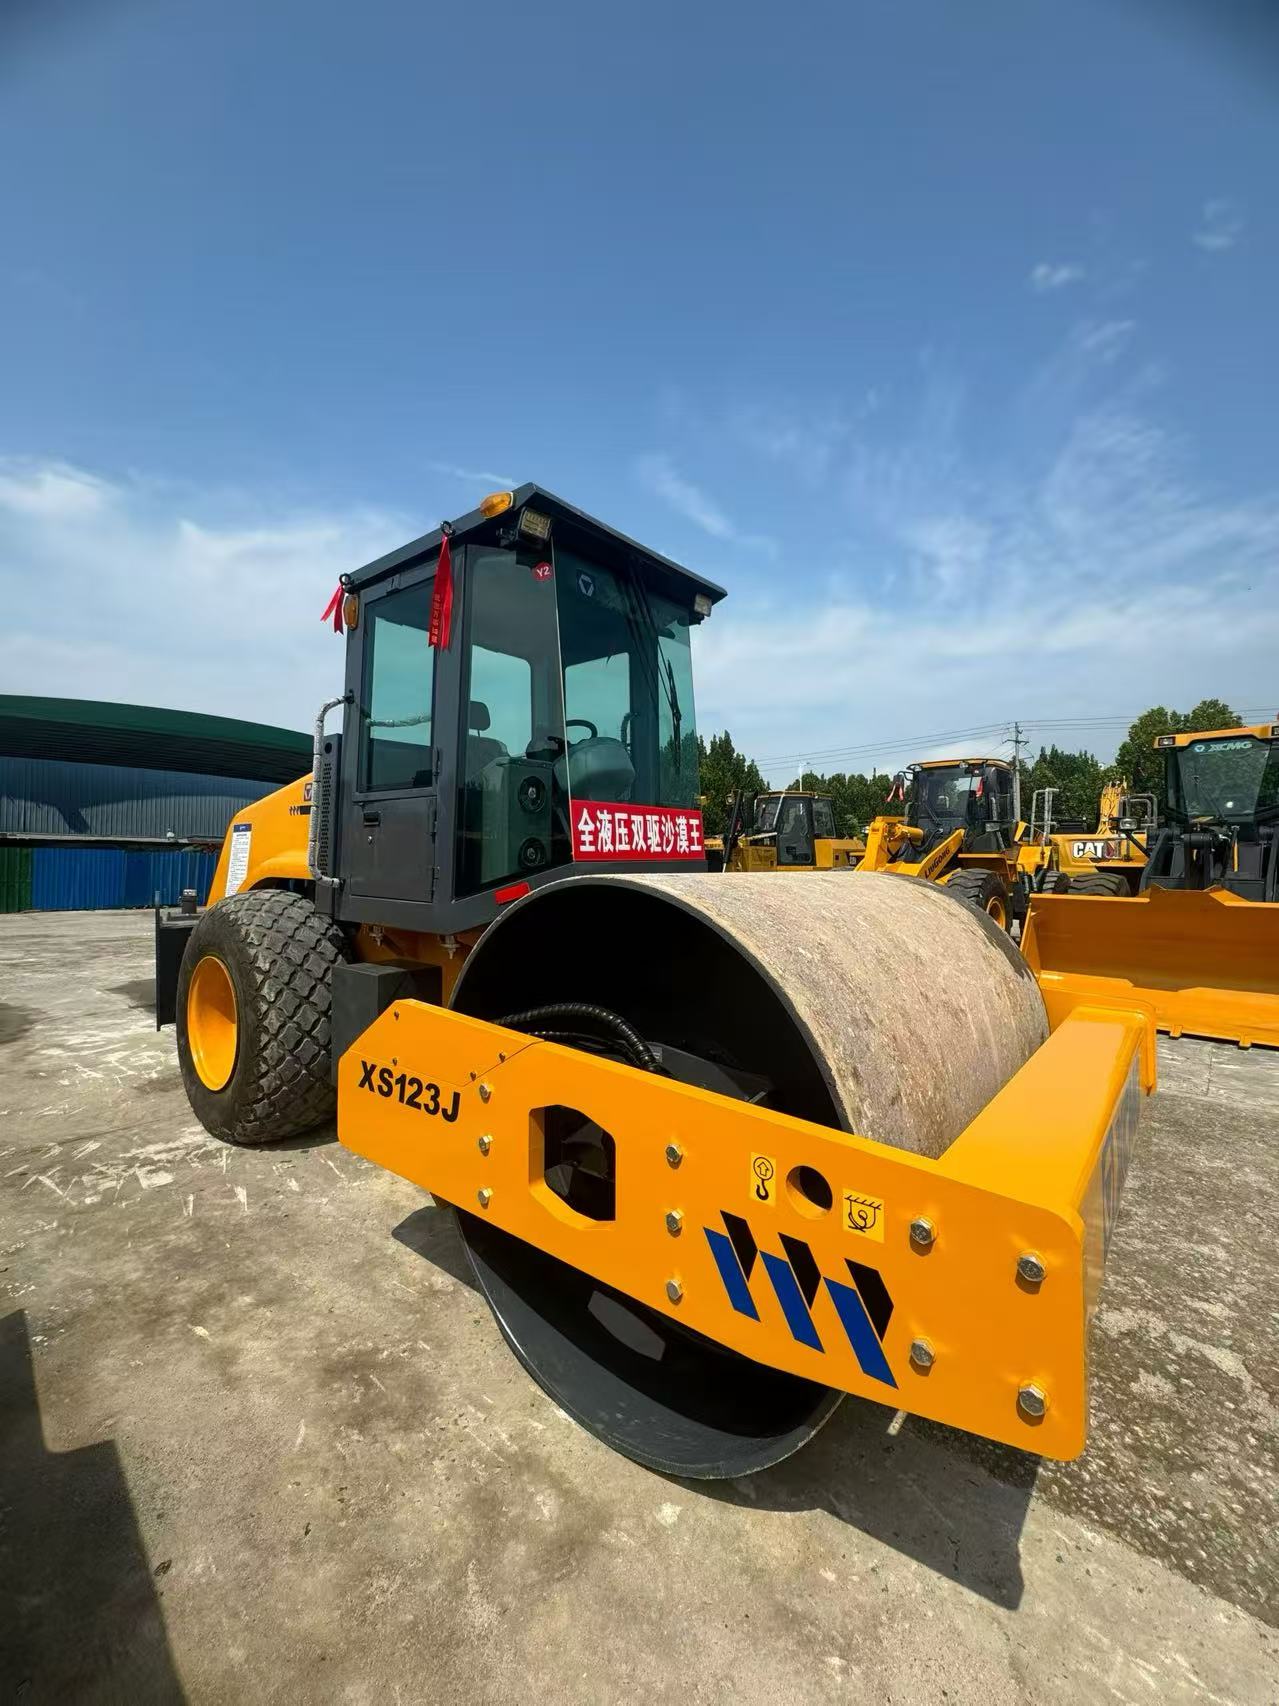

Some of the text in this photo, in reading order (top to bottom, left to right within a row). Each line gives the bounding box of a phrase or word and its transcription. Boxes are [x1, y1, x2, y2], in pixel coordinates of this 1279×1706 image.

[536, 566, 551, 577] Y2
[1209, 741, 1252, 752] XCMG
[577, 807, 702, 854] 全液压双驱沙漠王
[1073, 842, 1104, 858] CAT
[358, 1060, 462, 1122] XS123J
